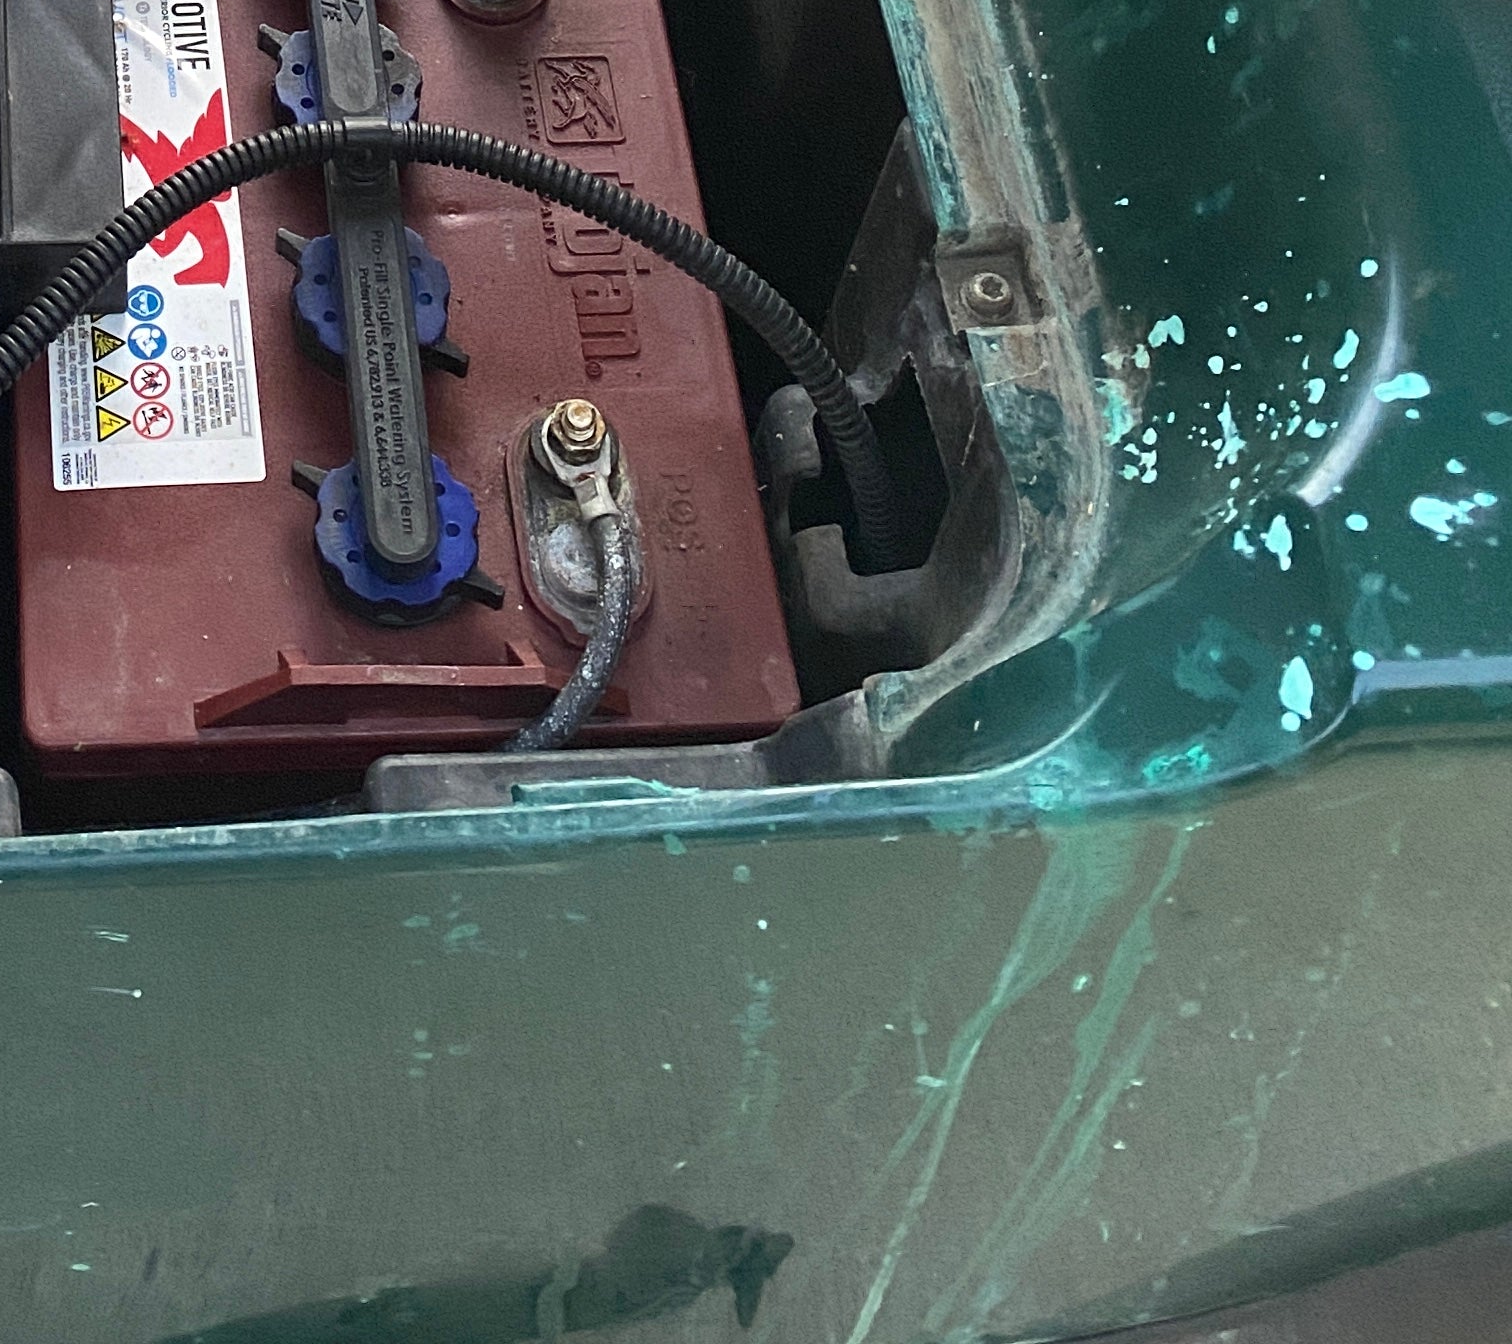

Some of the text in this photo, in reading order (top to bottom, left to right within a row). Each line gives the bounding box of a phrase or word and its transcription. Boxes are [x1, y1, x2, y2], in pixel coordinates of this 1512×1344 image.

[359, 266, 375, 331] Patented
[548, 170, 650, 358] ojan
[366, 331, 378, 347] US
[371, 230, 414, 535] Pro-Fill Single Point Watering System
